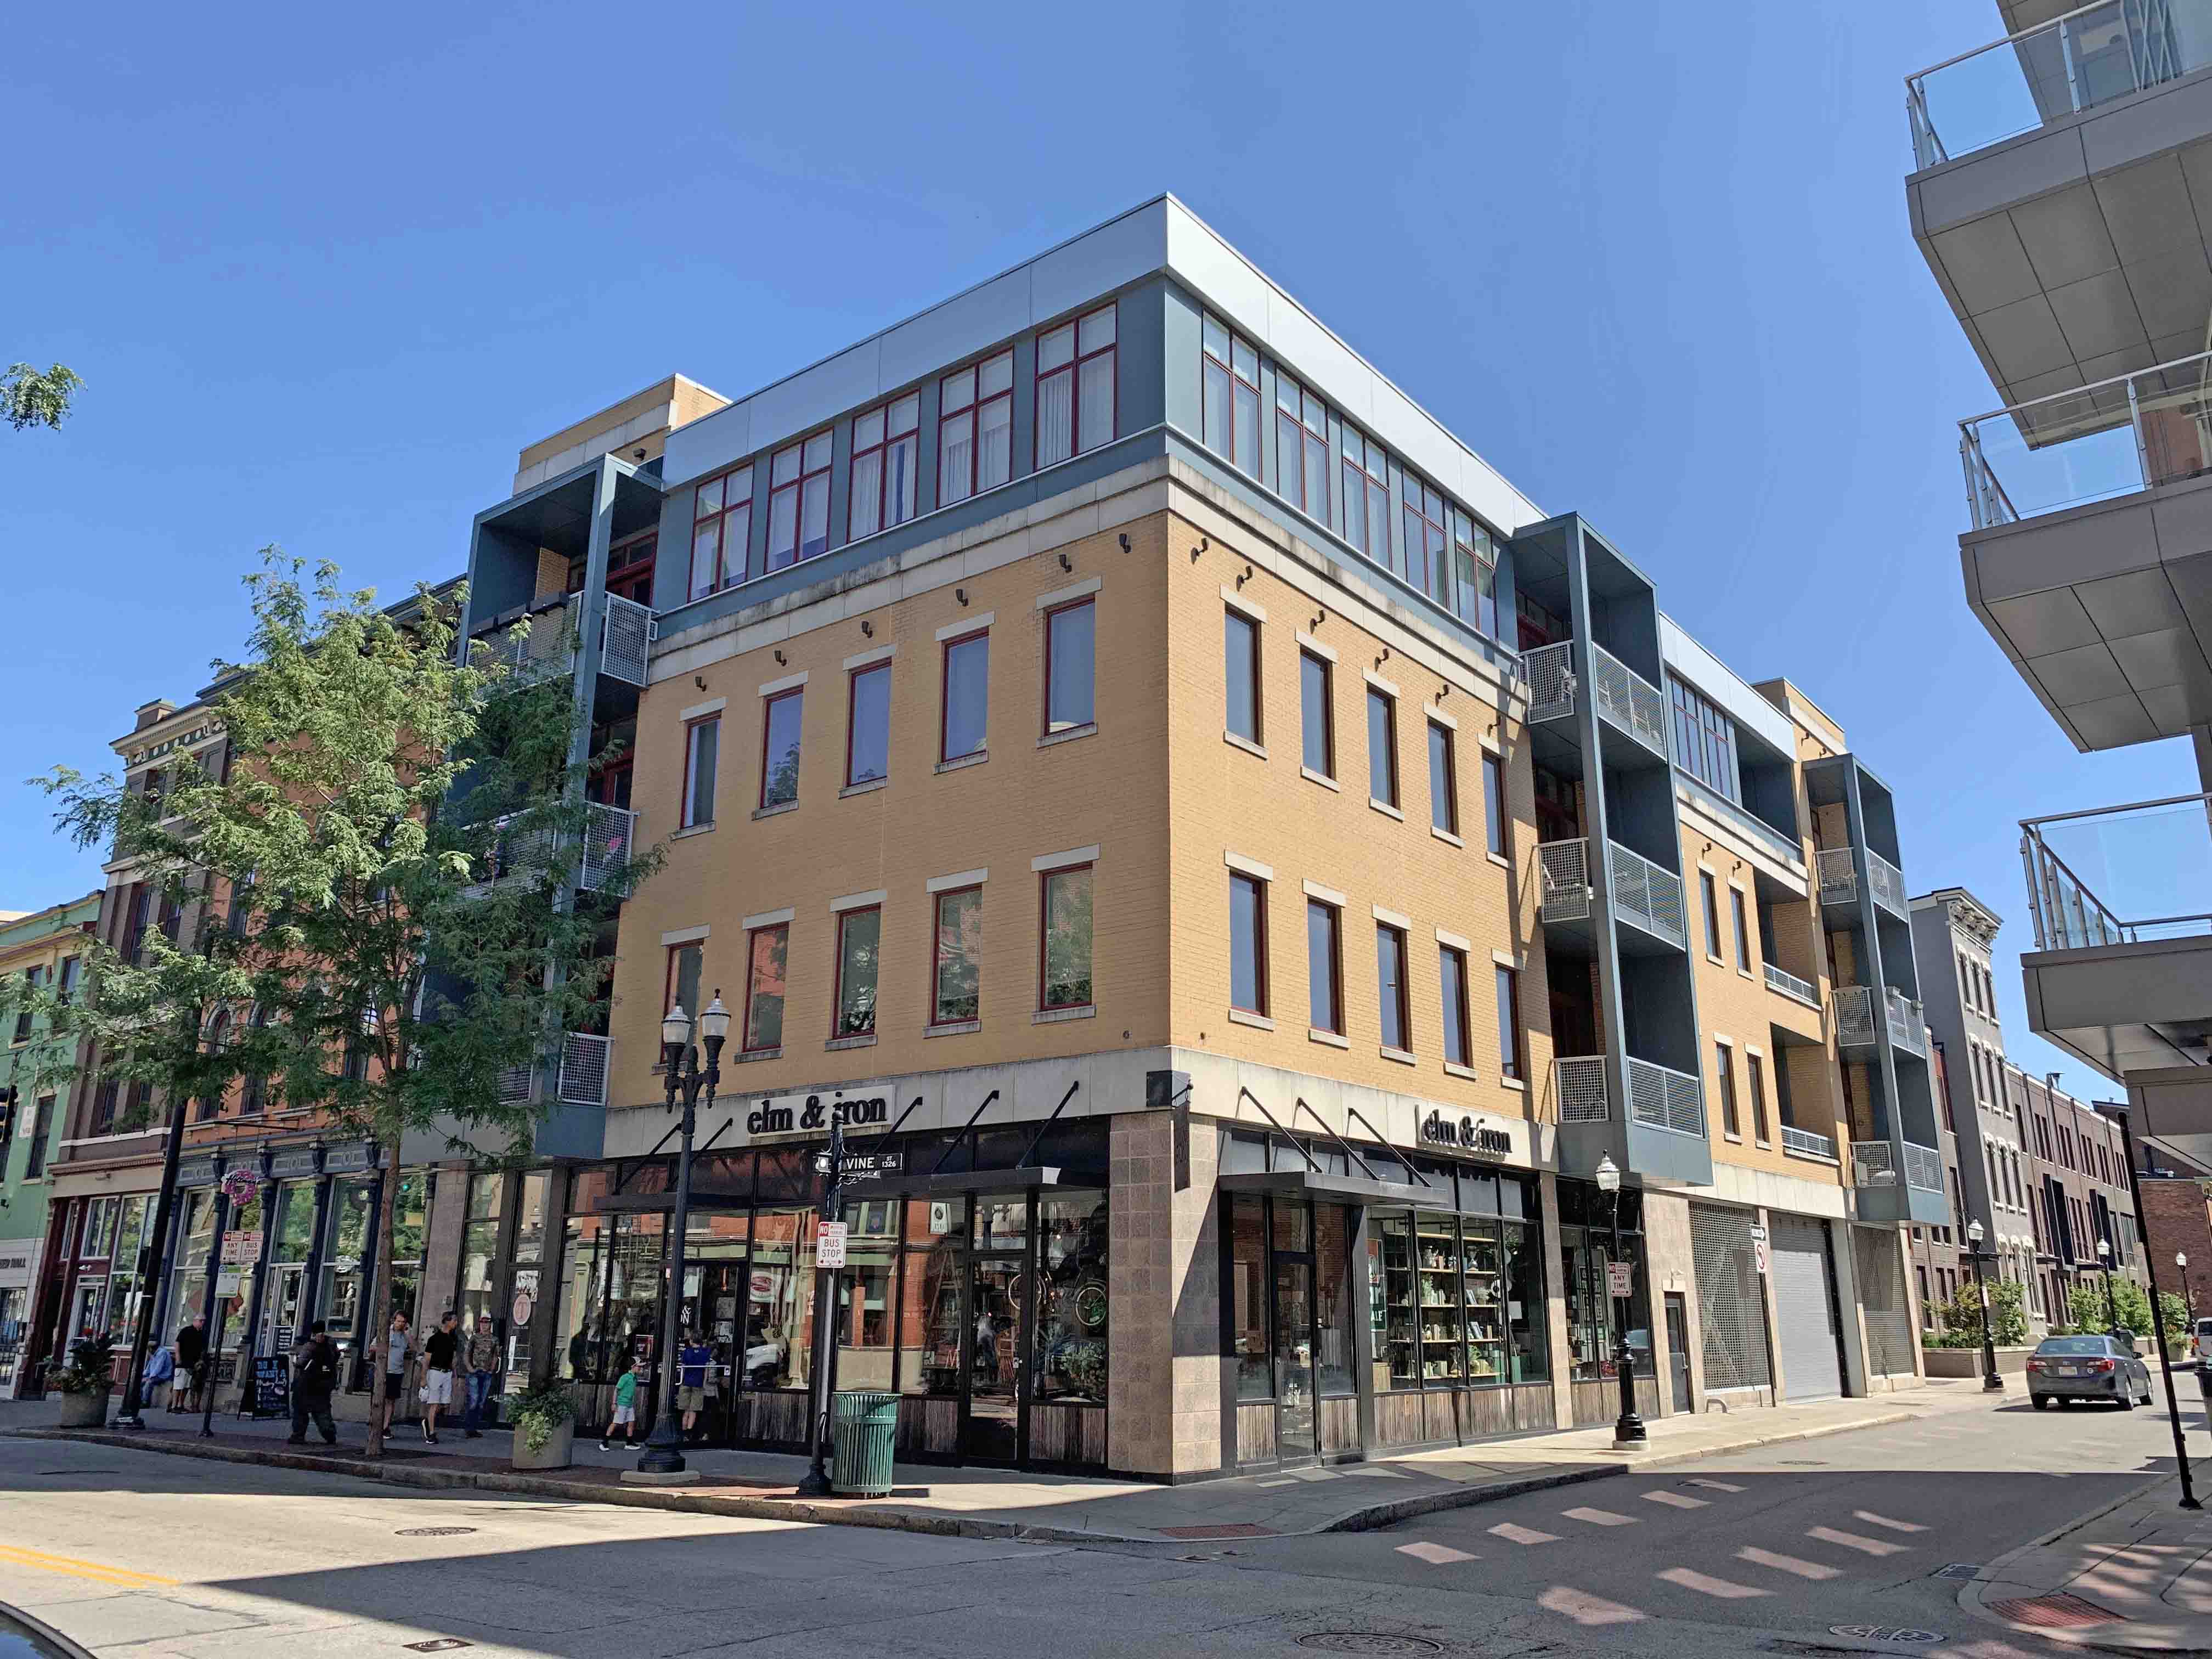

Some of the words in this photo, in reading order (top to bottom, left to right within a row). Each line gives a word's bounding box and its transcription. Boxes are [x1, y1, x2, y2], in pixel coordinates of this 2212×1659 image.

[747, 1099, 793, 1134] elm
[799, 1095, 825, 1129] &
[832, 1091, 887, 1124] iron
[1426, 1109, 1458, 1143] elm
[1459, 1116, 1477, 1147] &
[1478, 1118, 1512, 1153] iron
[847, 1157, 875, 1170] VINE
[820, 1225, 828, 1234] NO
[825, 1239, 839, 1247] BUS
[821, 1249, 841, 1258] STOP
[1609, 1264, 1616, 1273] NO
